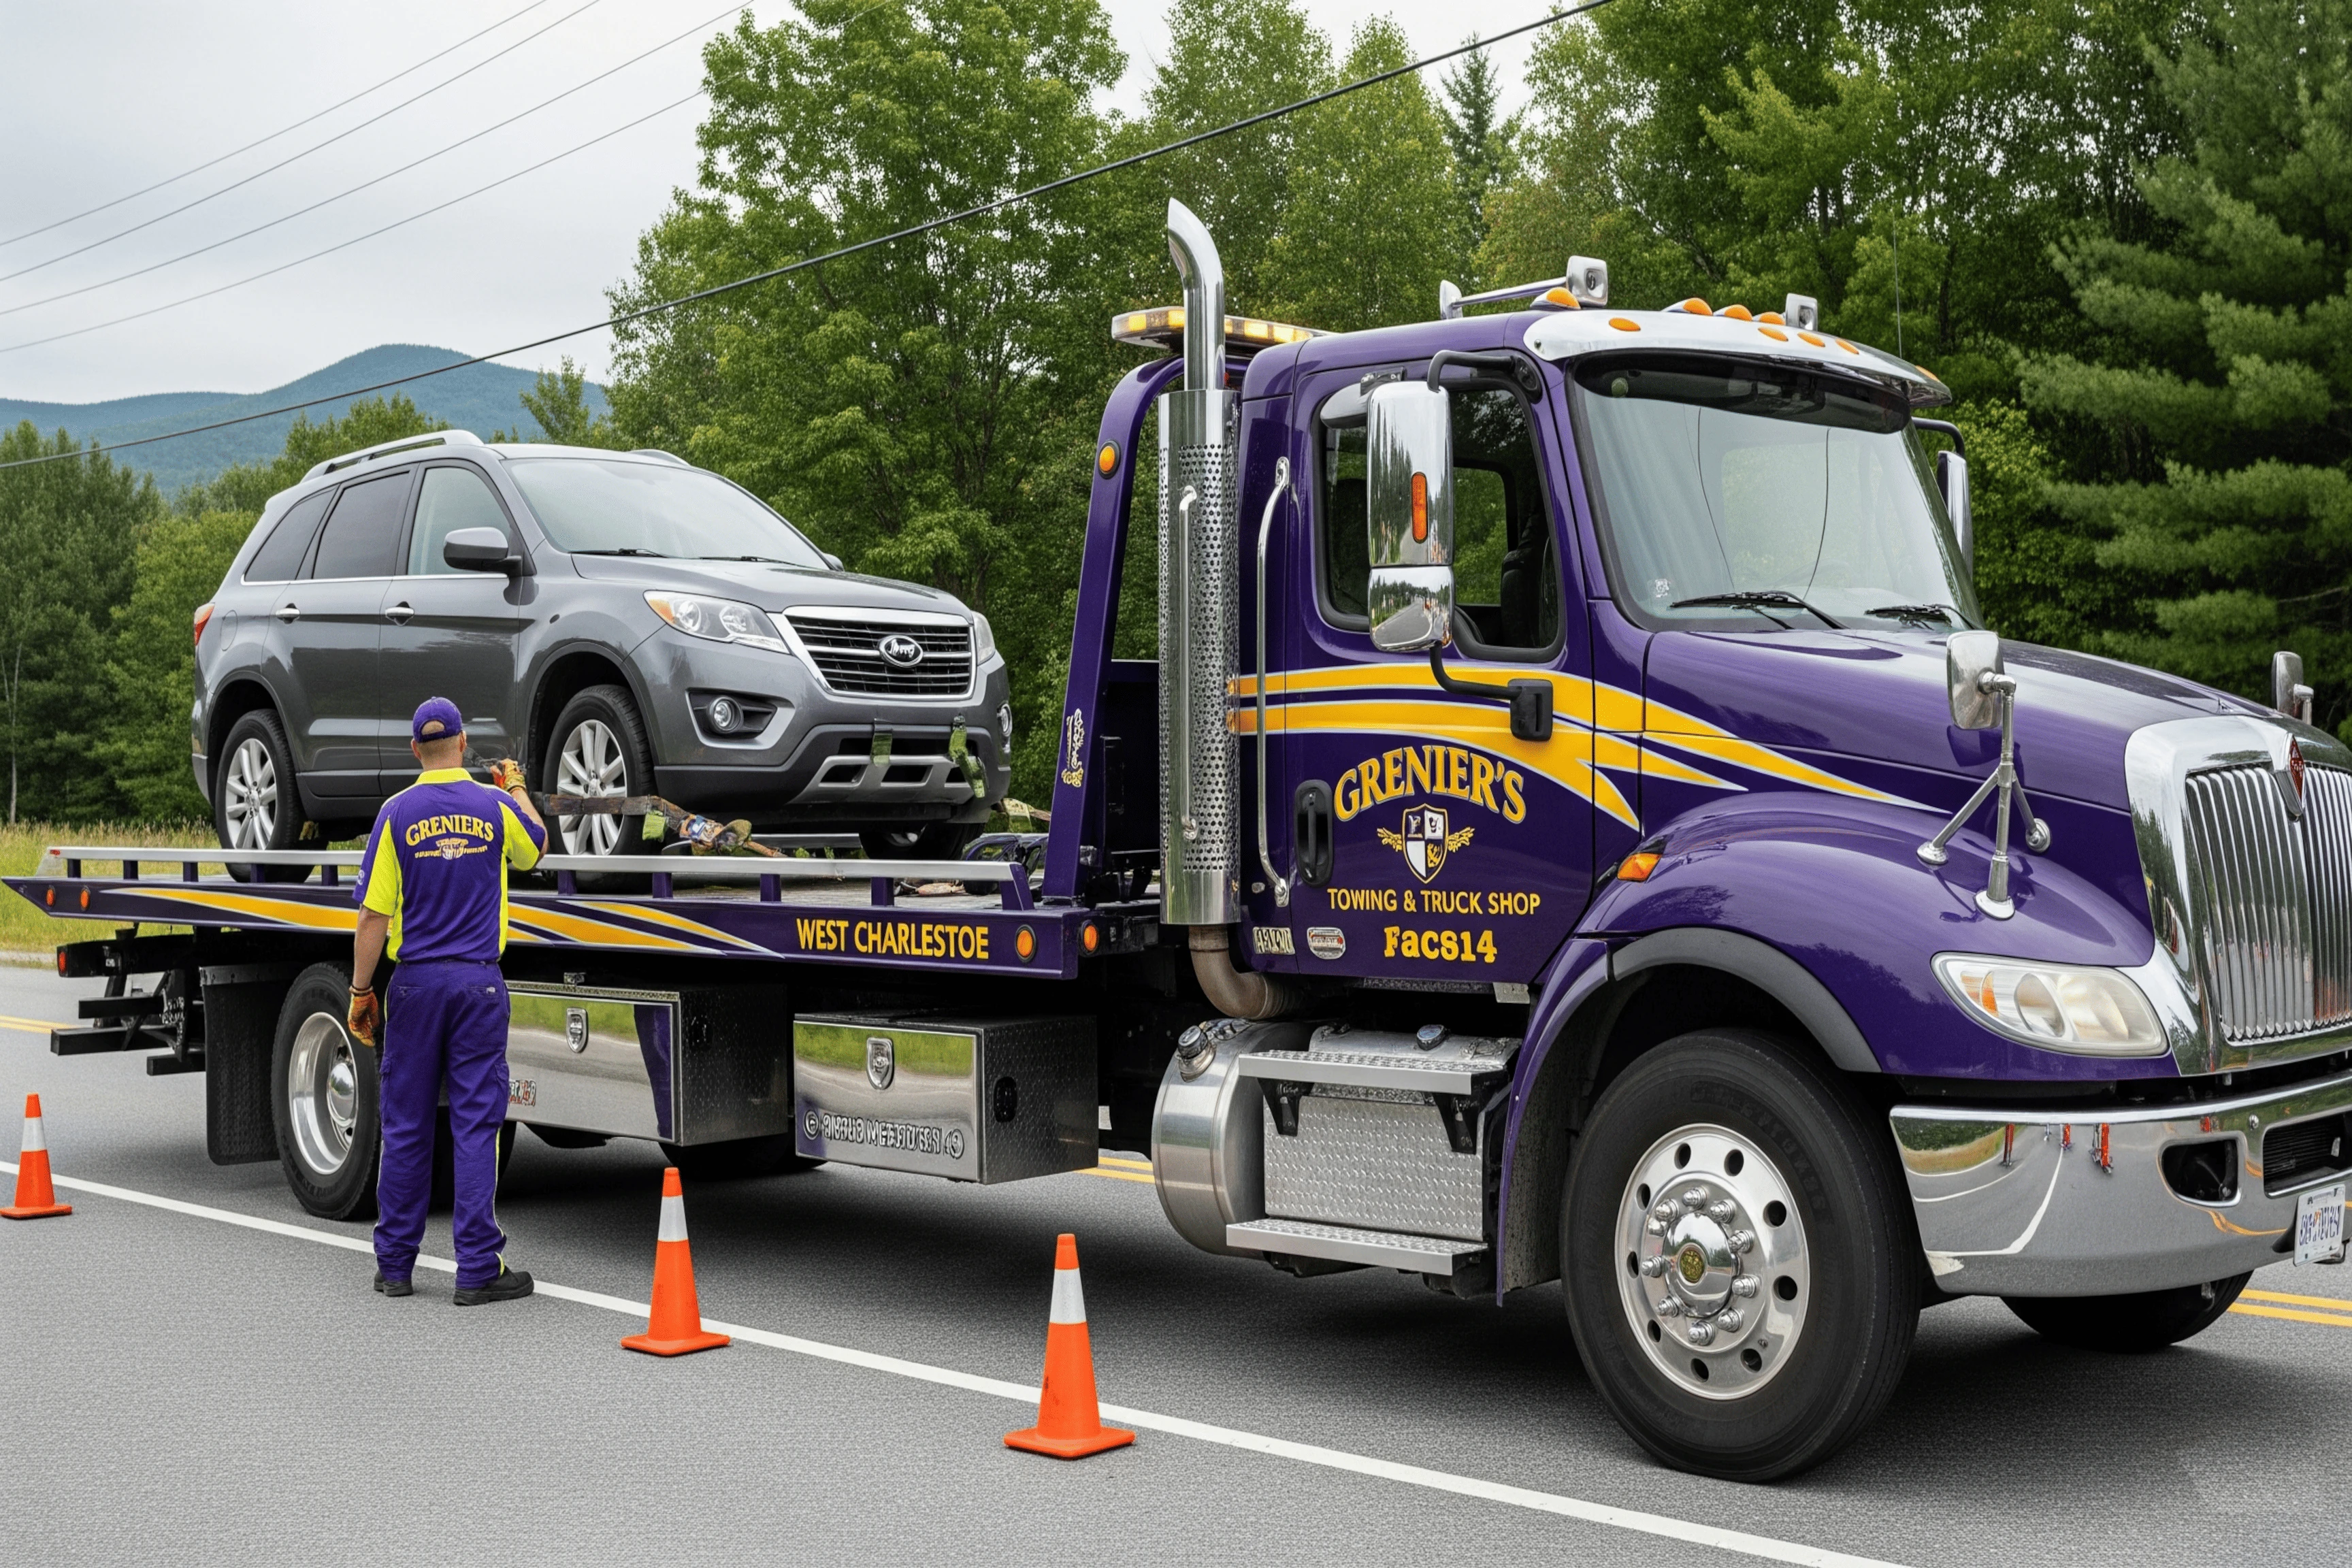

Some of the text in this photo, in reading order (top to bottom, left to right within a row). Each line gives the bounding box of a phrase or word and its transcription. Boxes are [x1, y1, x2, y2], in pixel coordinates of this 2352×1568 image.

[1335, 746, 1526, 823] GRENIER'S
[406, 815, 493, 846] GRENIERS
[1328, 889, 1540, 915] TOWING & TRUCK SHOP
[796, 919, 989, 959] WEST CHARLESTOE
